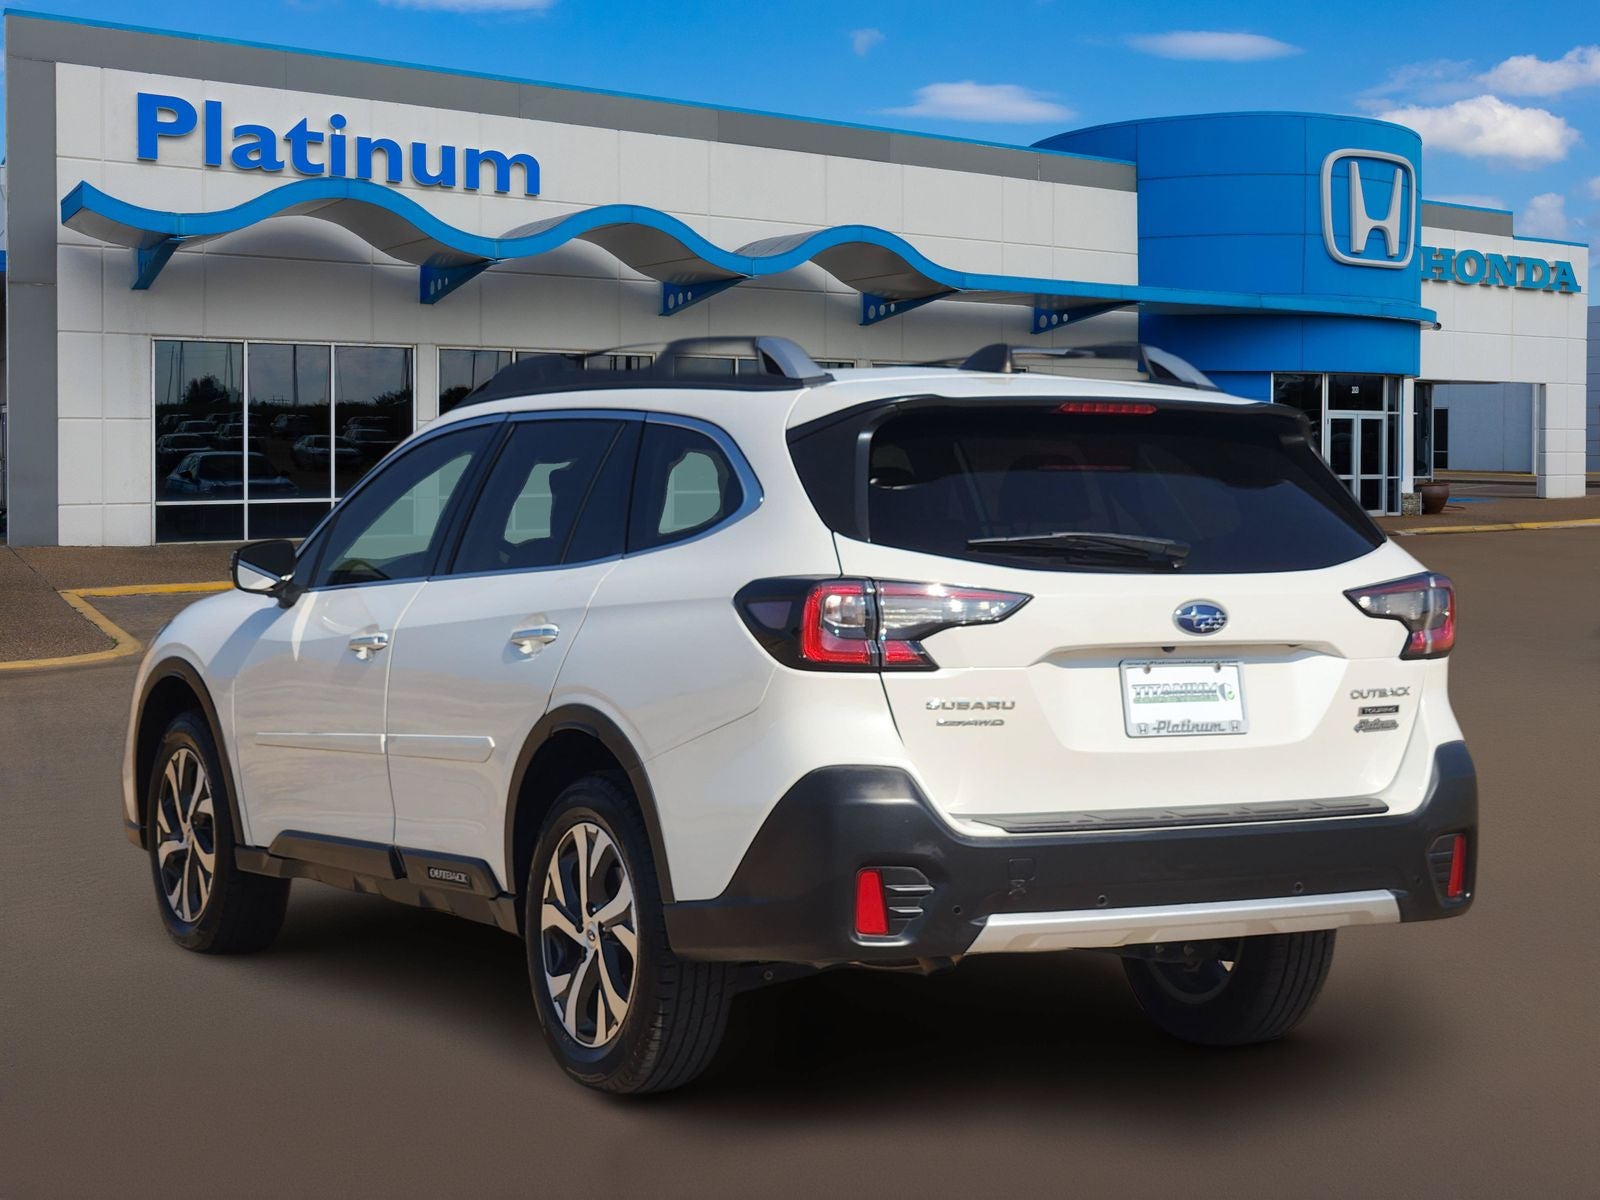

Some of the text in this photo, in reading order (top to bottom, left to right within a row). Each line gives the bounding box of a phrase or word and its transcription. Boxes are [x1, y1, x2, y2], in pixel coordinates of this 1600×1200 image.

[137, 92, 541, 196] Platinum
[1421, 246, 1581, 293] HONDA
[1350, 686, 1410, 700] OUTBACK
[925, 700, 1016, 711] SUBARU
[1152, 719, 1226, 734] Platinum
[429, 867, 470, 884] OUTBACK
